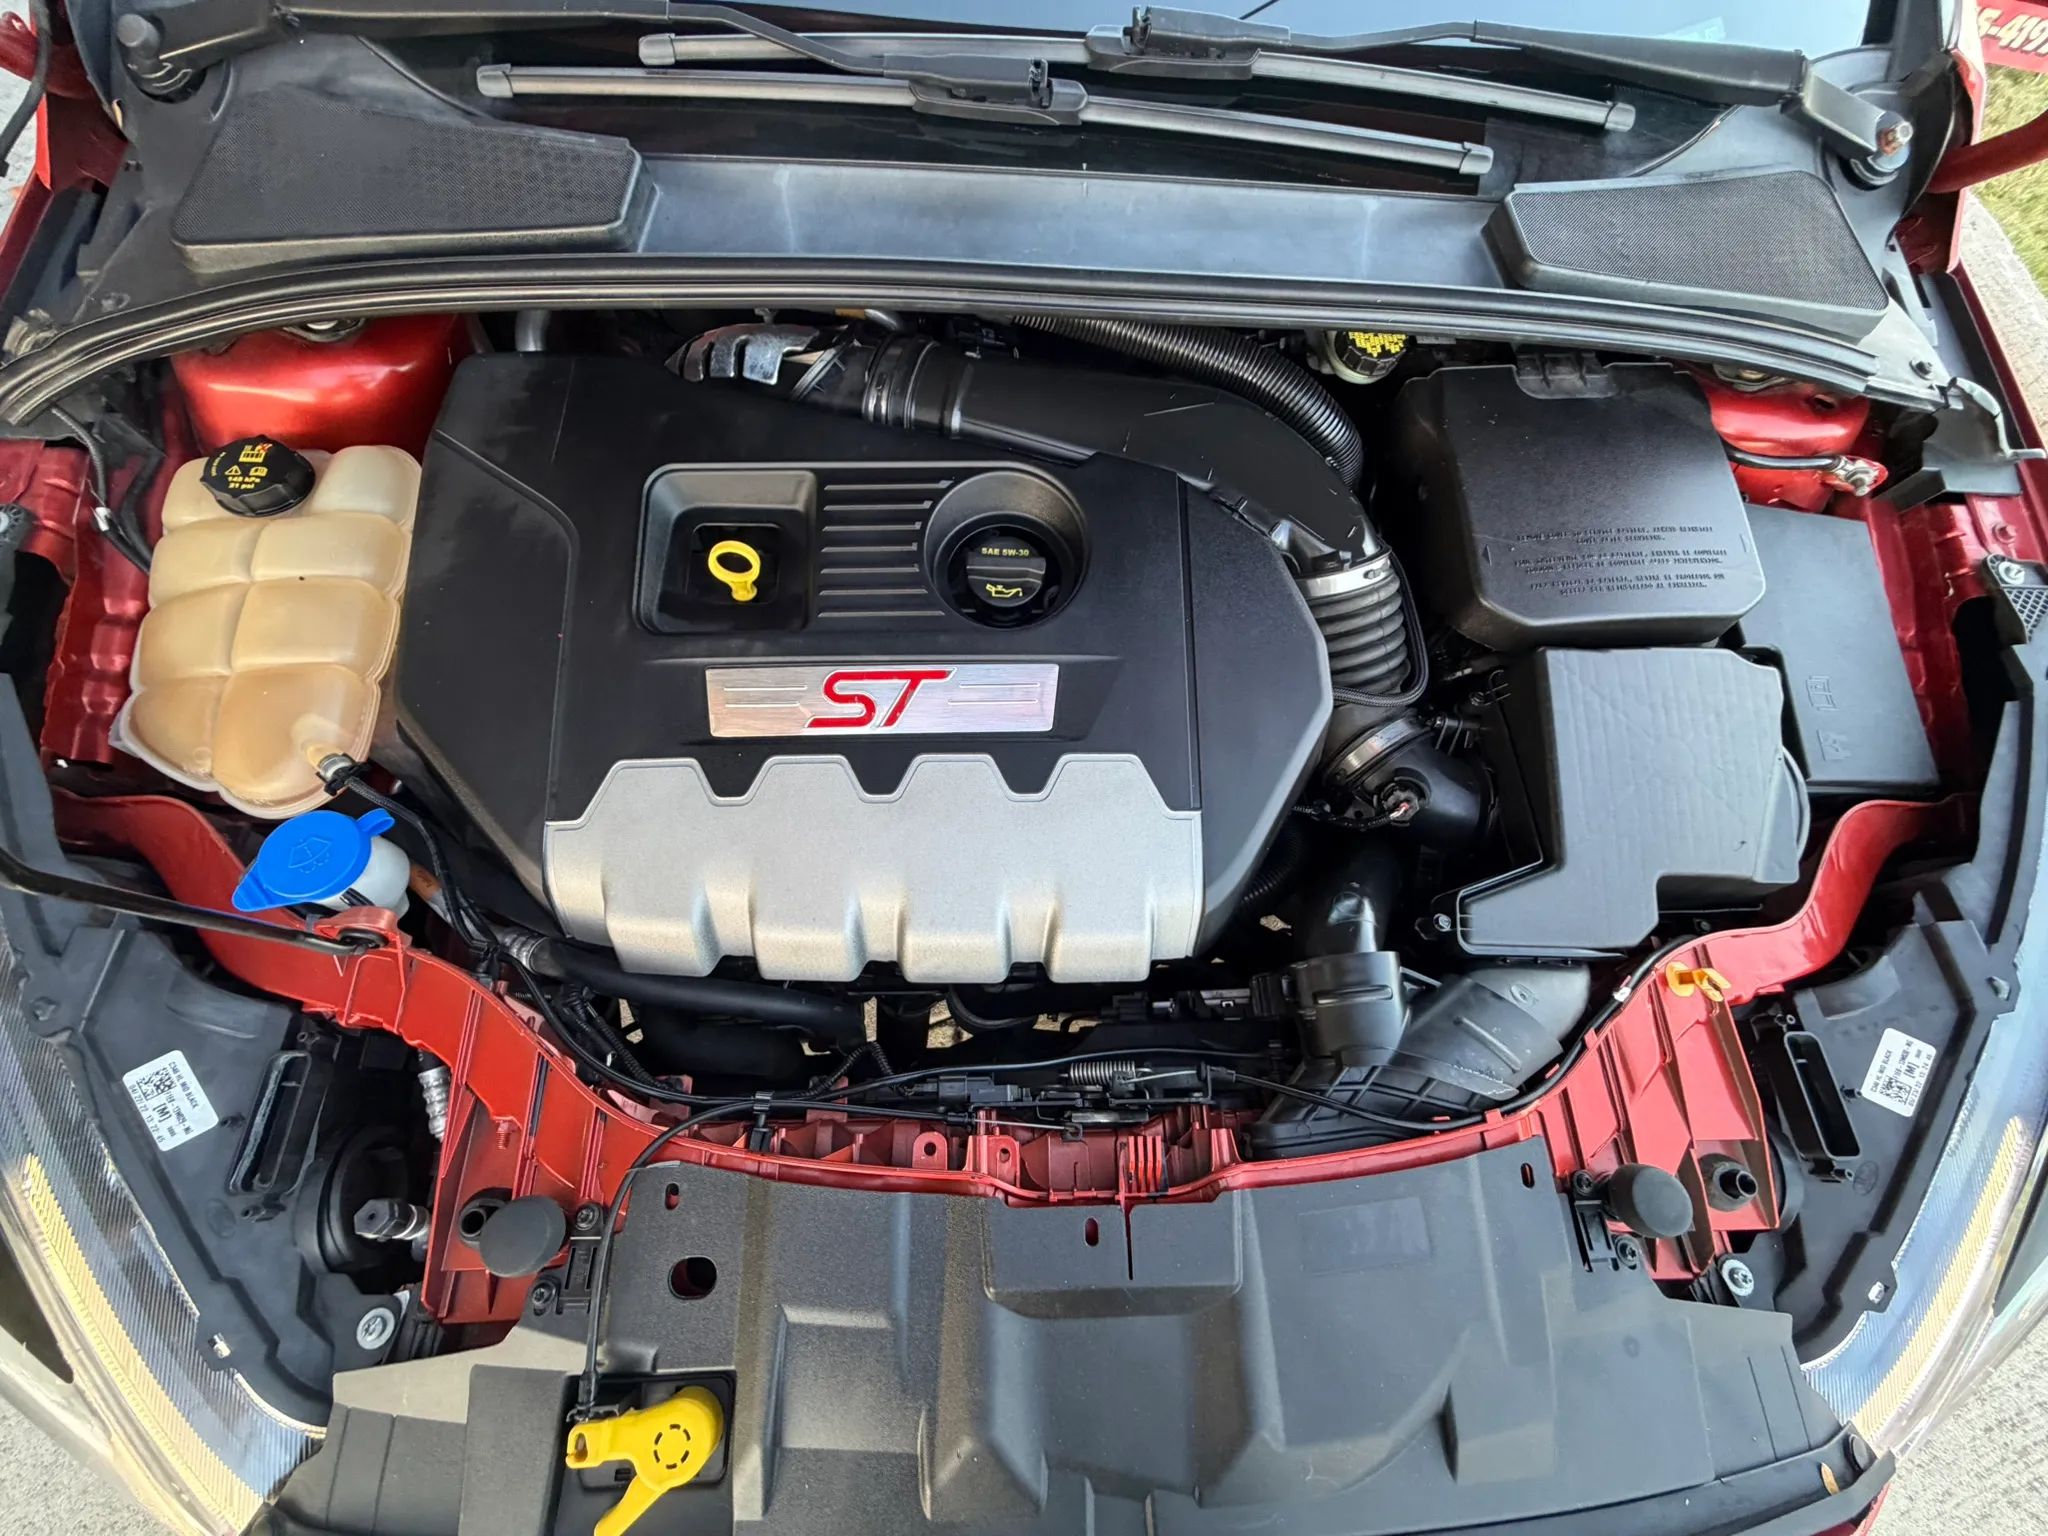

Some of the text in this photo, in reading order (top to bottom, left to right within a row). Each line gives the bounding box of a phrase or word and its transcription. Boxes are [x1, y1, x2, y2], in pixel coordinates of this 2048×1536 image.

[1002, 548, 1030, 556] 5W-30
[806, 668, 957, 729] ST
[185, 1091, 199, 1108] BLACK
